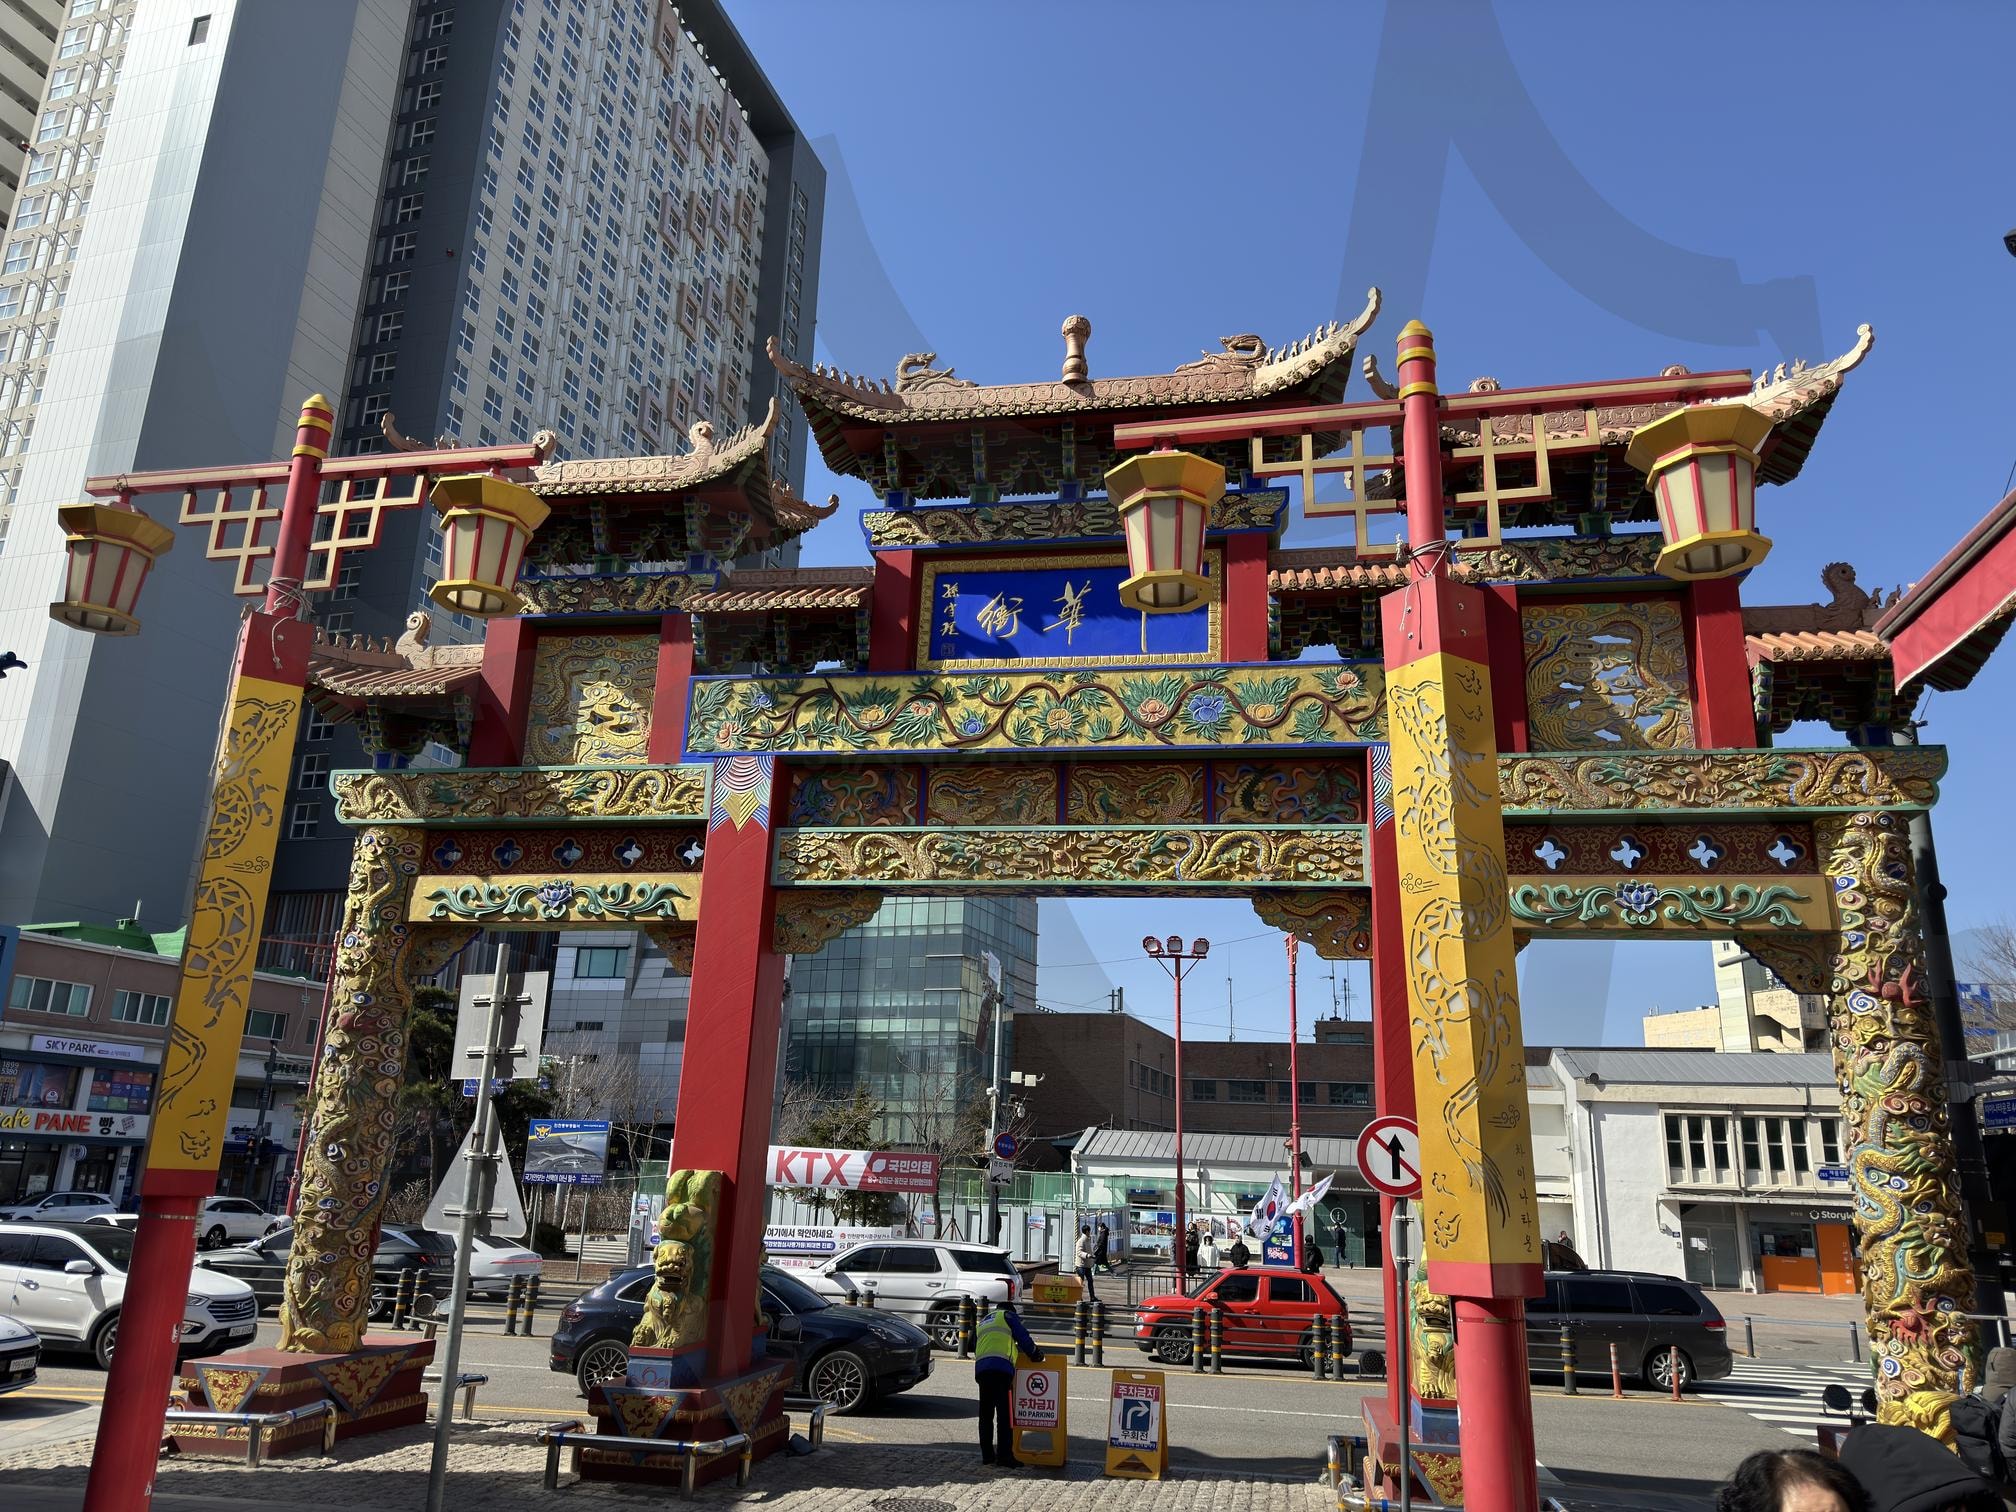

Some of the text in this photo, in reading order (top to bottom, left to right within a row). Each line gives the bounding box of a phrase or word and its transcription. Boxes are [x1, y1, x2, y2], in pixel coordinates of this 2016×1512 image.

[45, 1039, 68, 1051] SKY
[69, 1042, 97, 1055] PARK
[34, 1112, 92, 1133] PANE
[775, 1150, 851, 1187] KTX
[888, 1159, 932, 1175] 국민의힘
[766, 1227, 796, 1238] 여기에서
[1119, 1385, 1156, 1399] 주차금지
[1018, 1397, 1055, 1411] 주차금지
[1018, 1410, 1055, 1419] NO PARKING
[1121, 1430, 1149, 1442] 우회전
